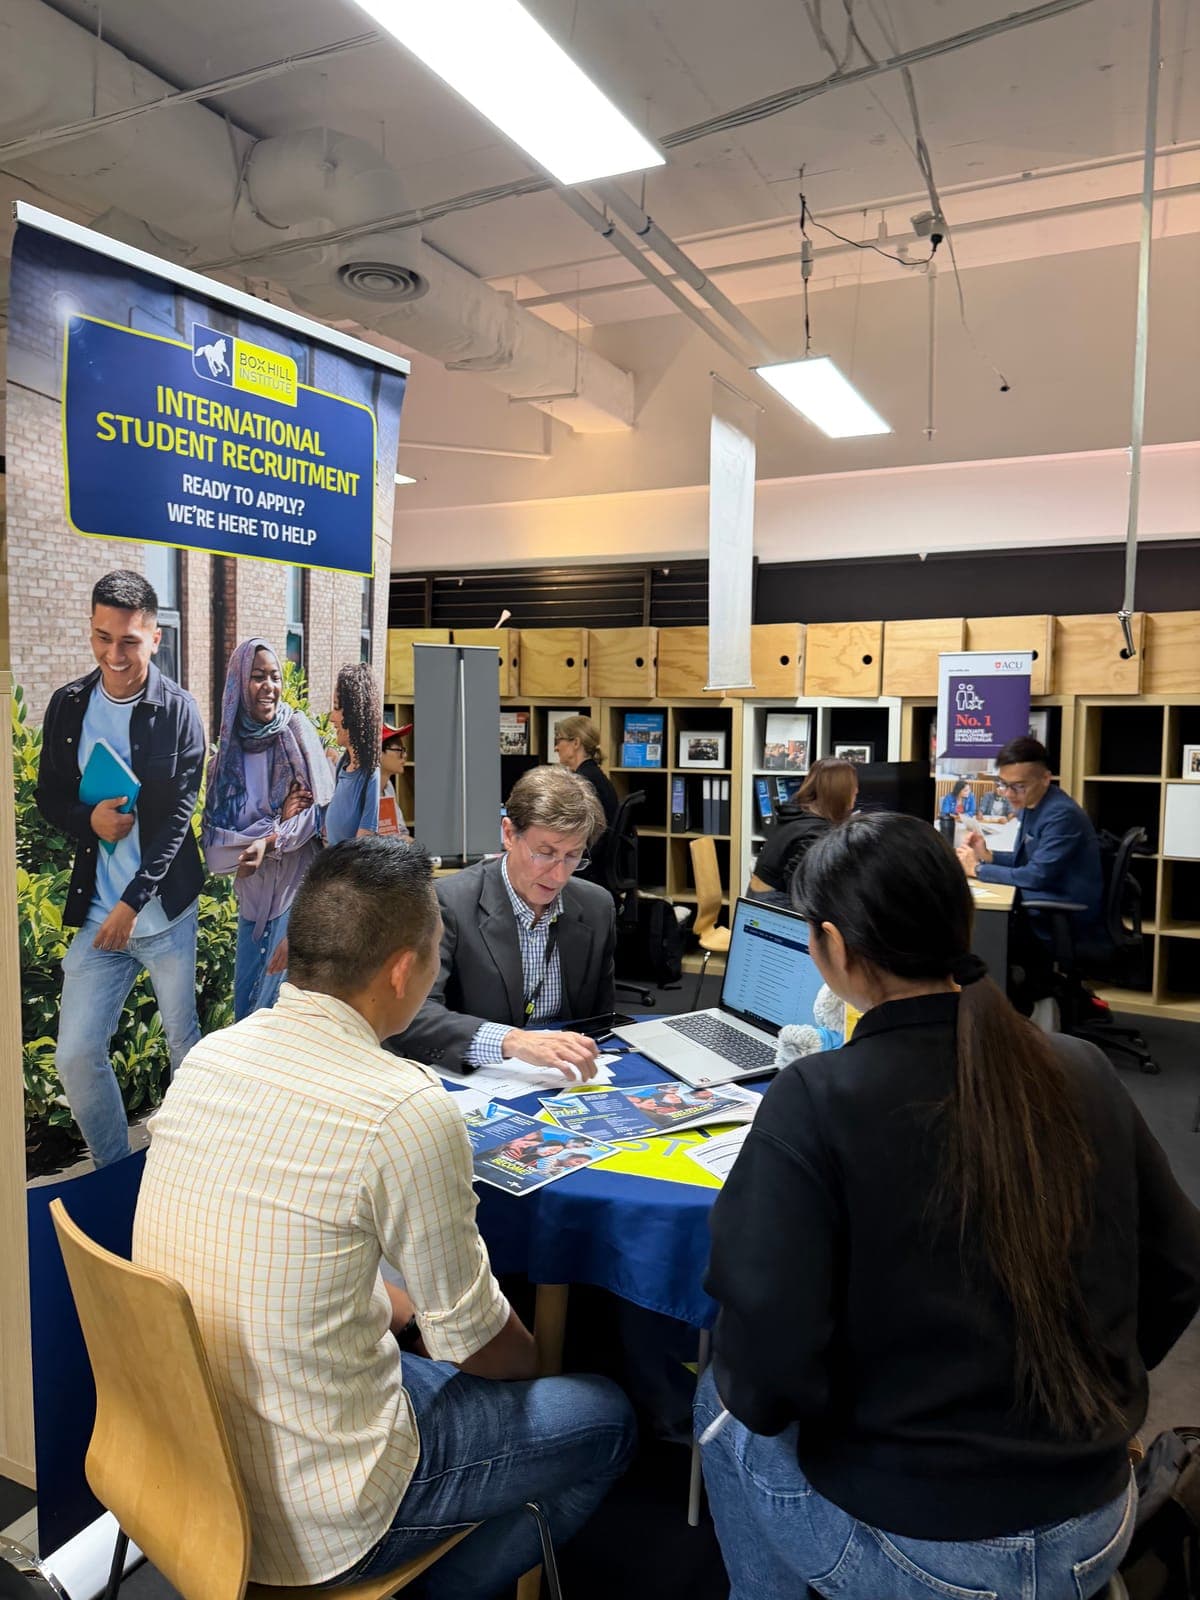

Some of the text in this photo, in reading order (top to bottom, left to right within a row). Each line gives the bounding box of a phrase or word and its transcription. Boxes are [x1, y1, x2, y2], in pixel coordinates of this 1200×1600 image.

[240, 352, 292, 382] BOX HILL
[240, 367, 292, 395] INSTITUTE
[157, 385, 326, 457] INTERNATIONAL
[96, 411, 360, 497] STUDENT RECRUITMENT
[183, 474, 305, 516] READY TO APPLY?
[167, 502, 317, 546] WE'RE HERE TO HELP
[1002, 661, 1023, 669] ACU
[955, 714, 992, 727] No. 1
